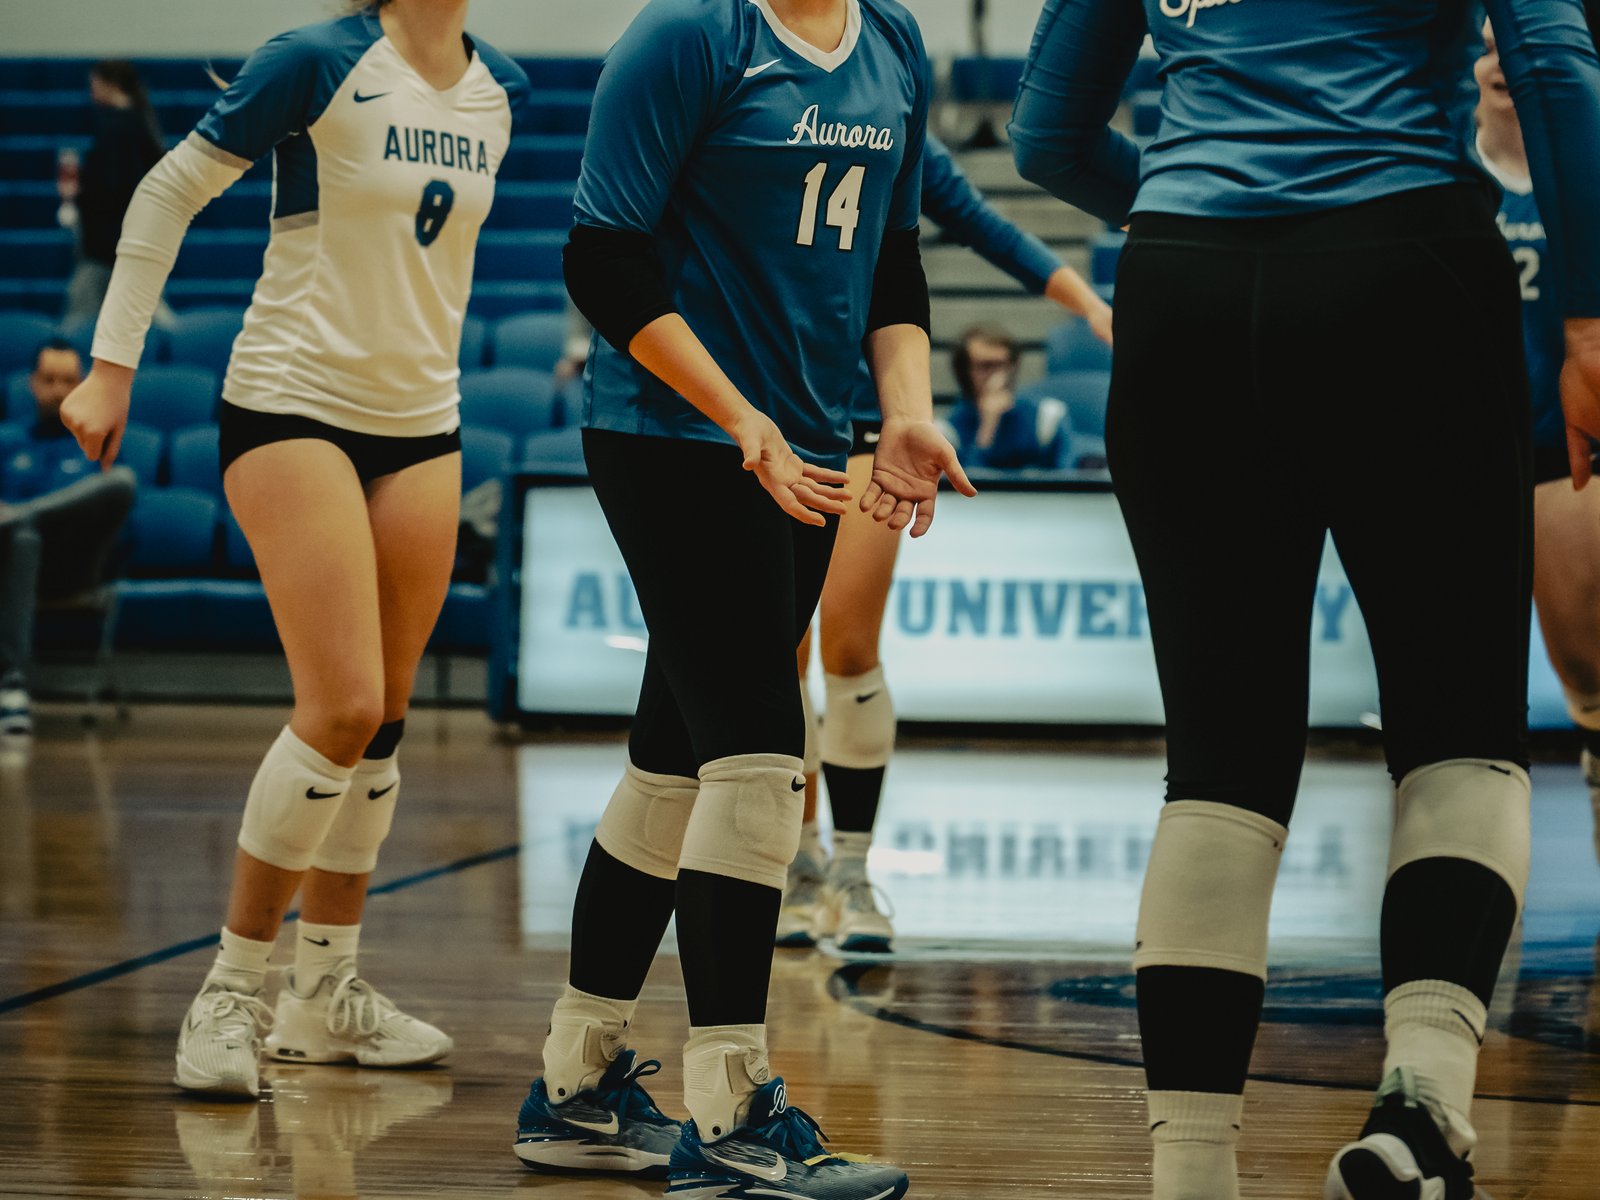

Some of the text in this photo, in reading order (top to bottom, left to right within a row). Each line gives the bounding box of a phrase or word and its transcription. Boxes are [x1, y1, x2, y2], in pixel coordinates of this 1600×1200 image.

[383, 125, 491, 176] AURORA
[785, 103, 894, 152] Aurora
[415, 179, 455, 247] 8
[795, 161, 868, 251] 14
